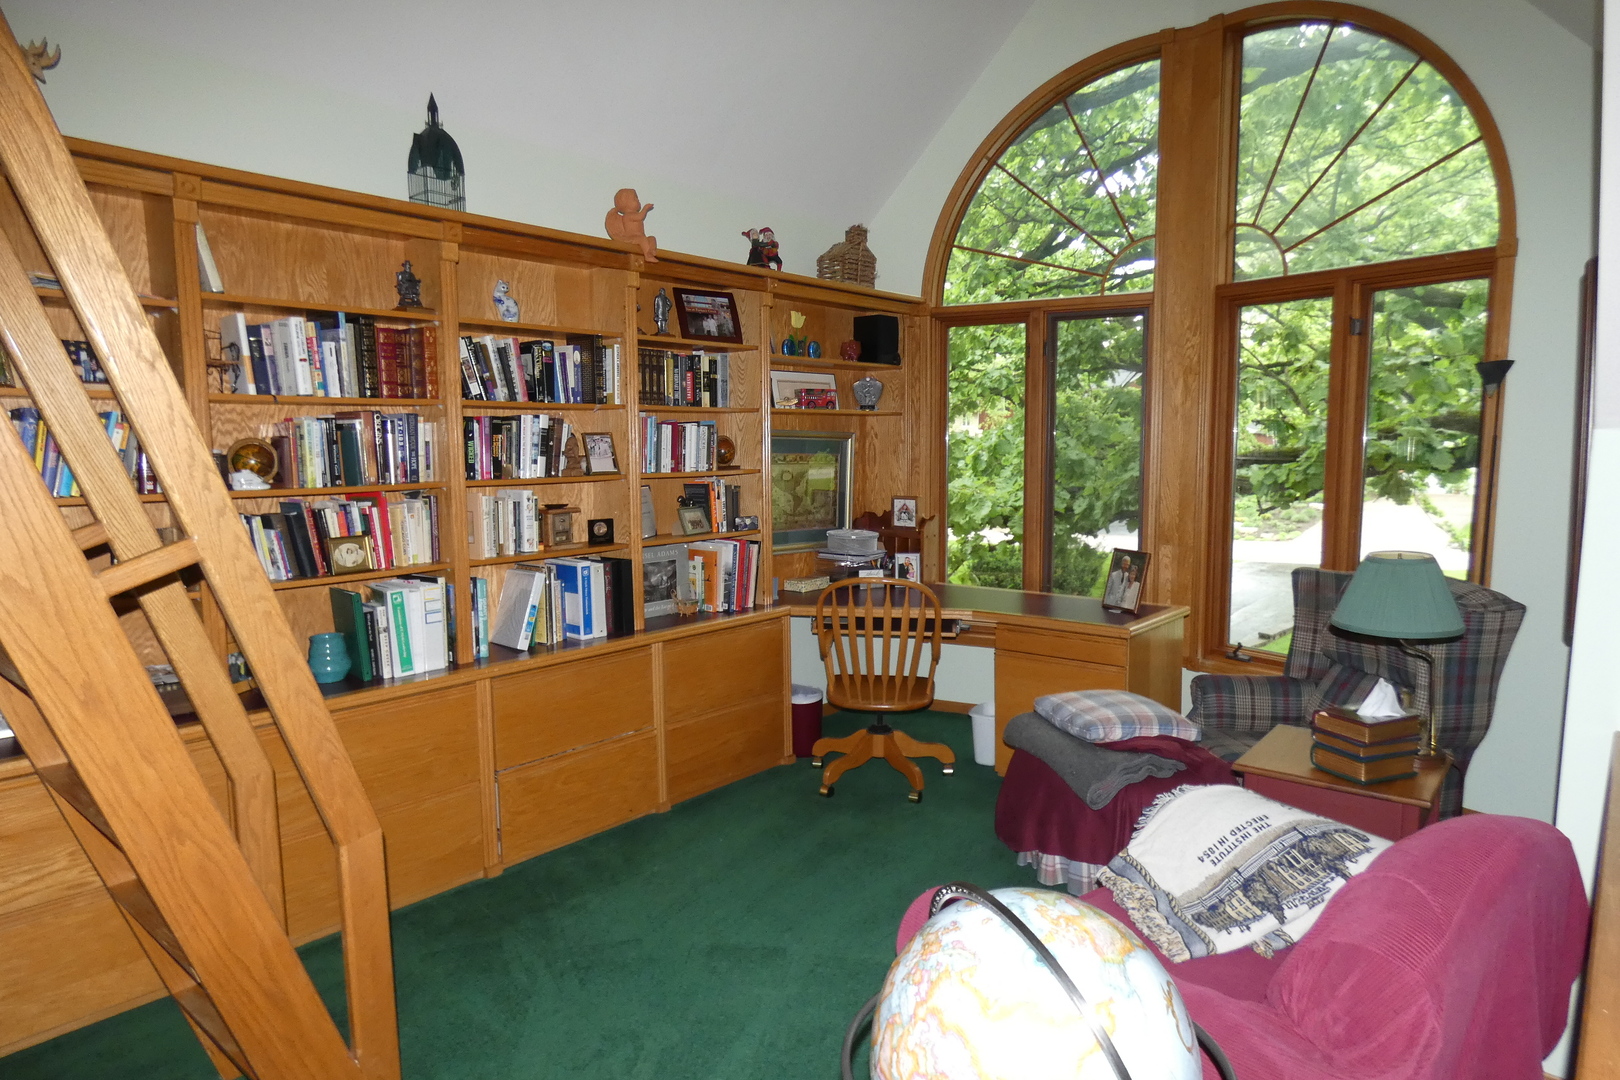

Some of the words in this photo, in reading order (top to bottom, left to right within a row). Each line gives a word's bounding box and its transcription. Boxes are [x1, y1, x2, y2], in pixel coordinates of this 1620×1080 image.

[374, 414, 383, 445] ORIGINS
[656, 549, 679, 557] ADAMS
[1229, 814, 1270, 837] ERECTED
[1252, 822, 1272, 833] THE
[1209, 831, 1252, 867] INSTITUTE
[1217, 835, 1229, 847] IN
[1197, 843, 1220, 863] 1854
